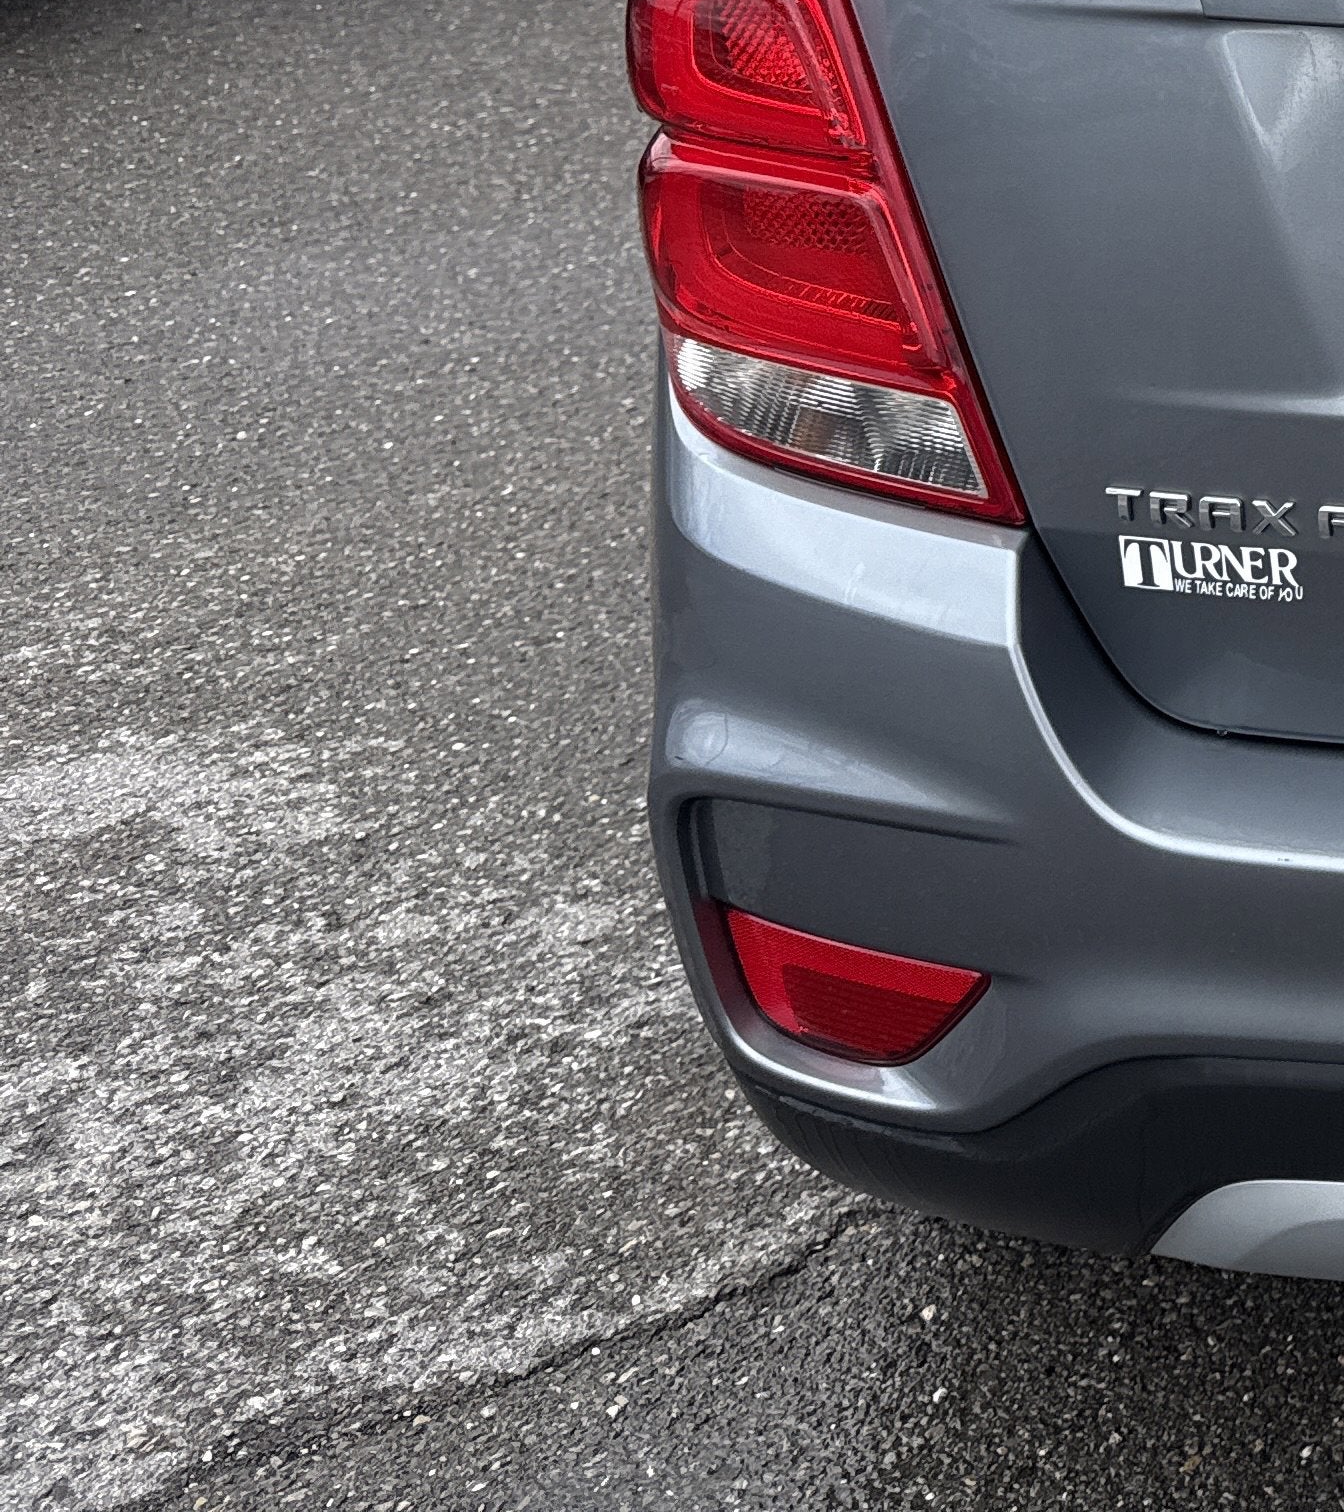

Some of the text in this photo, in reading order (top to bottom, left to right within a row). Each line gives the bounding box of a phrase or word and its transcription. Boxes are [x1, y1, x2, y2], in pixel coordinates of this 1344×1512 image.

[1105, 487, 1298, 537] TRAX
[1121, 536, 1301, 589] TURNER
[1174, 578, 1304, 602] WE TAKE CARE OF YOU
